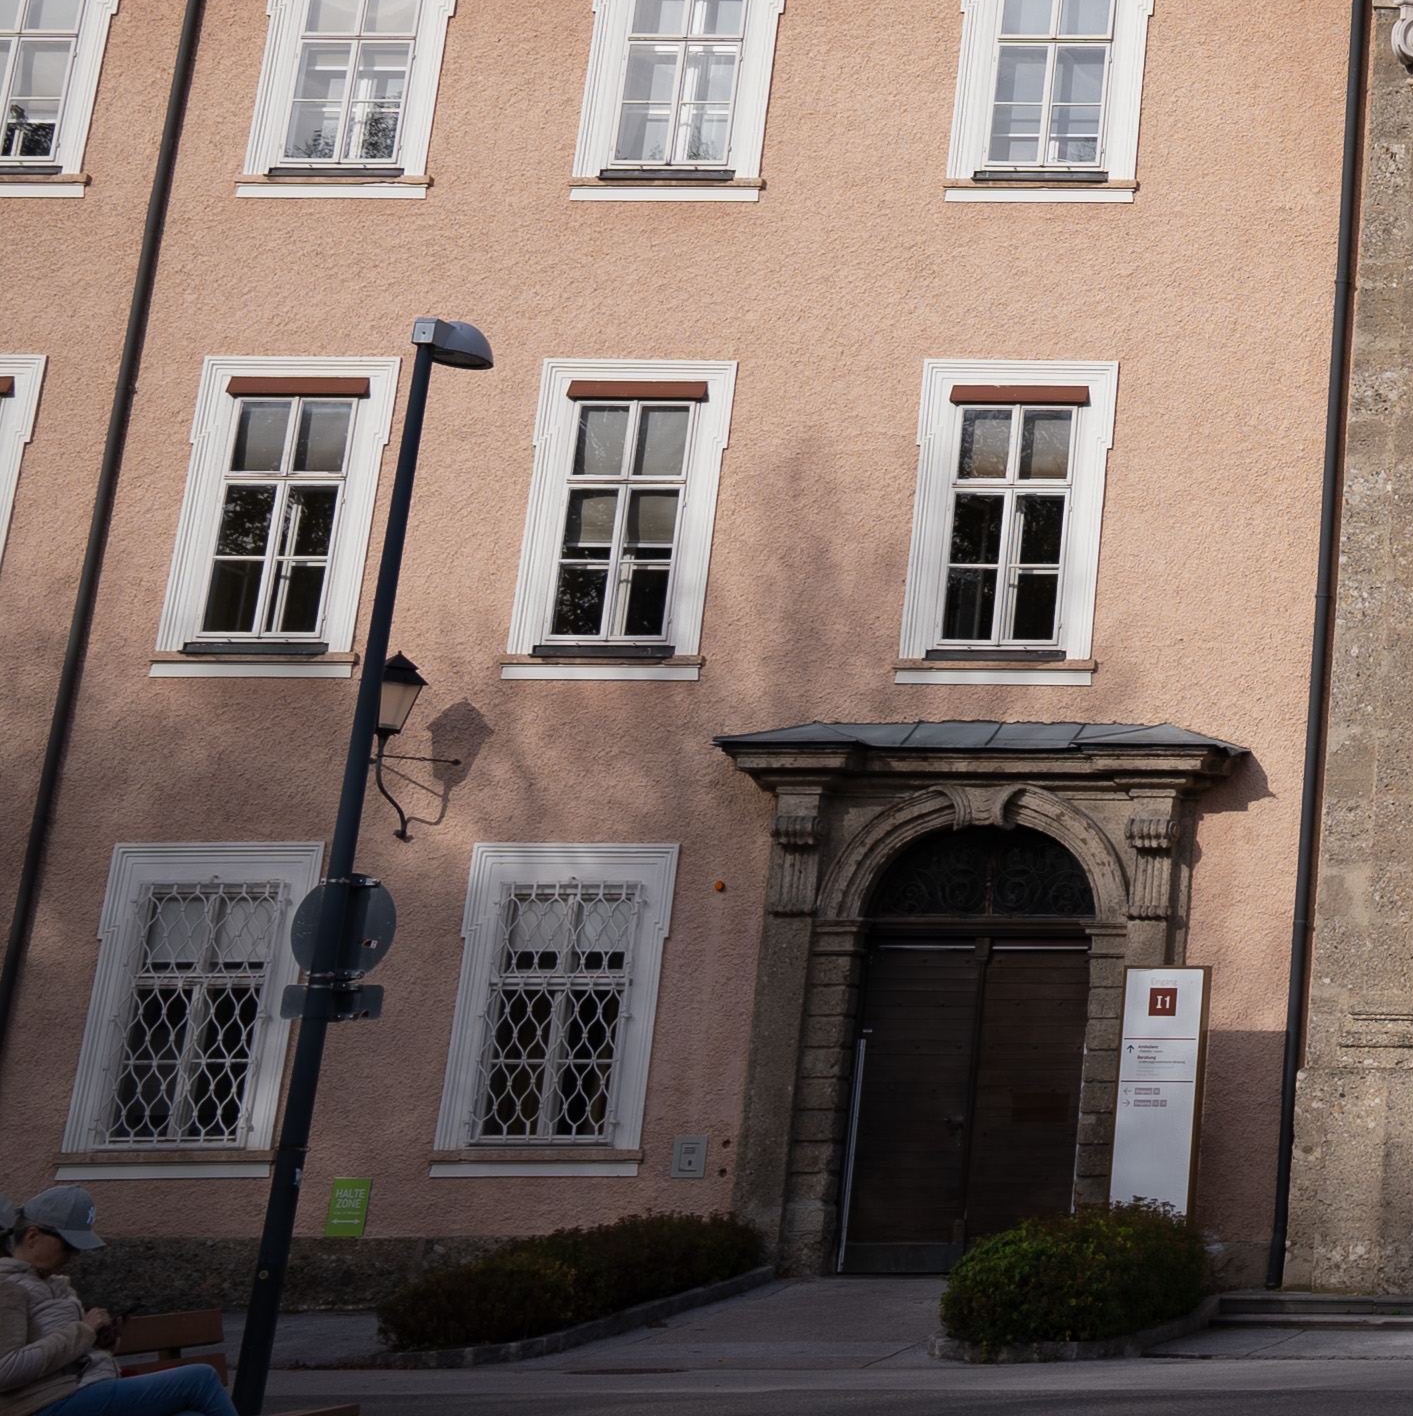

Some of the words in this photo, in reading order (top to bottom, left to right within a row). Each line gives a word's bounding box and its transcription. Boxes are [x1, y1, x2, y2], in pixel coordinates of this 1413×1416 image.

[1150, 978, 1177, 987] Eingang
[1156, 995, 1170, 1009] I1
[335, 1189, 365, 1199] HALTE
[335, 1199, 362, 1208] ZONE
